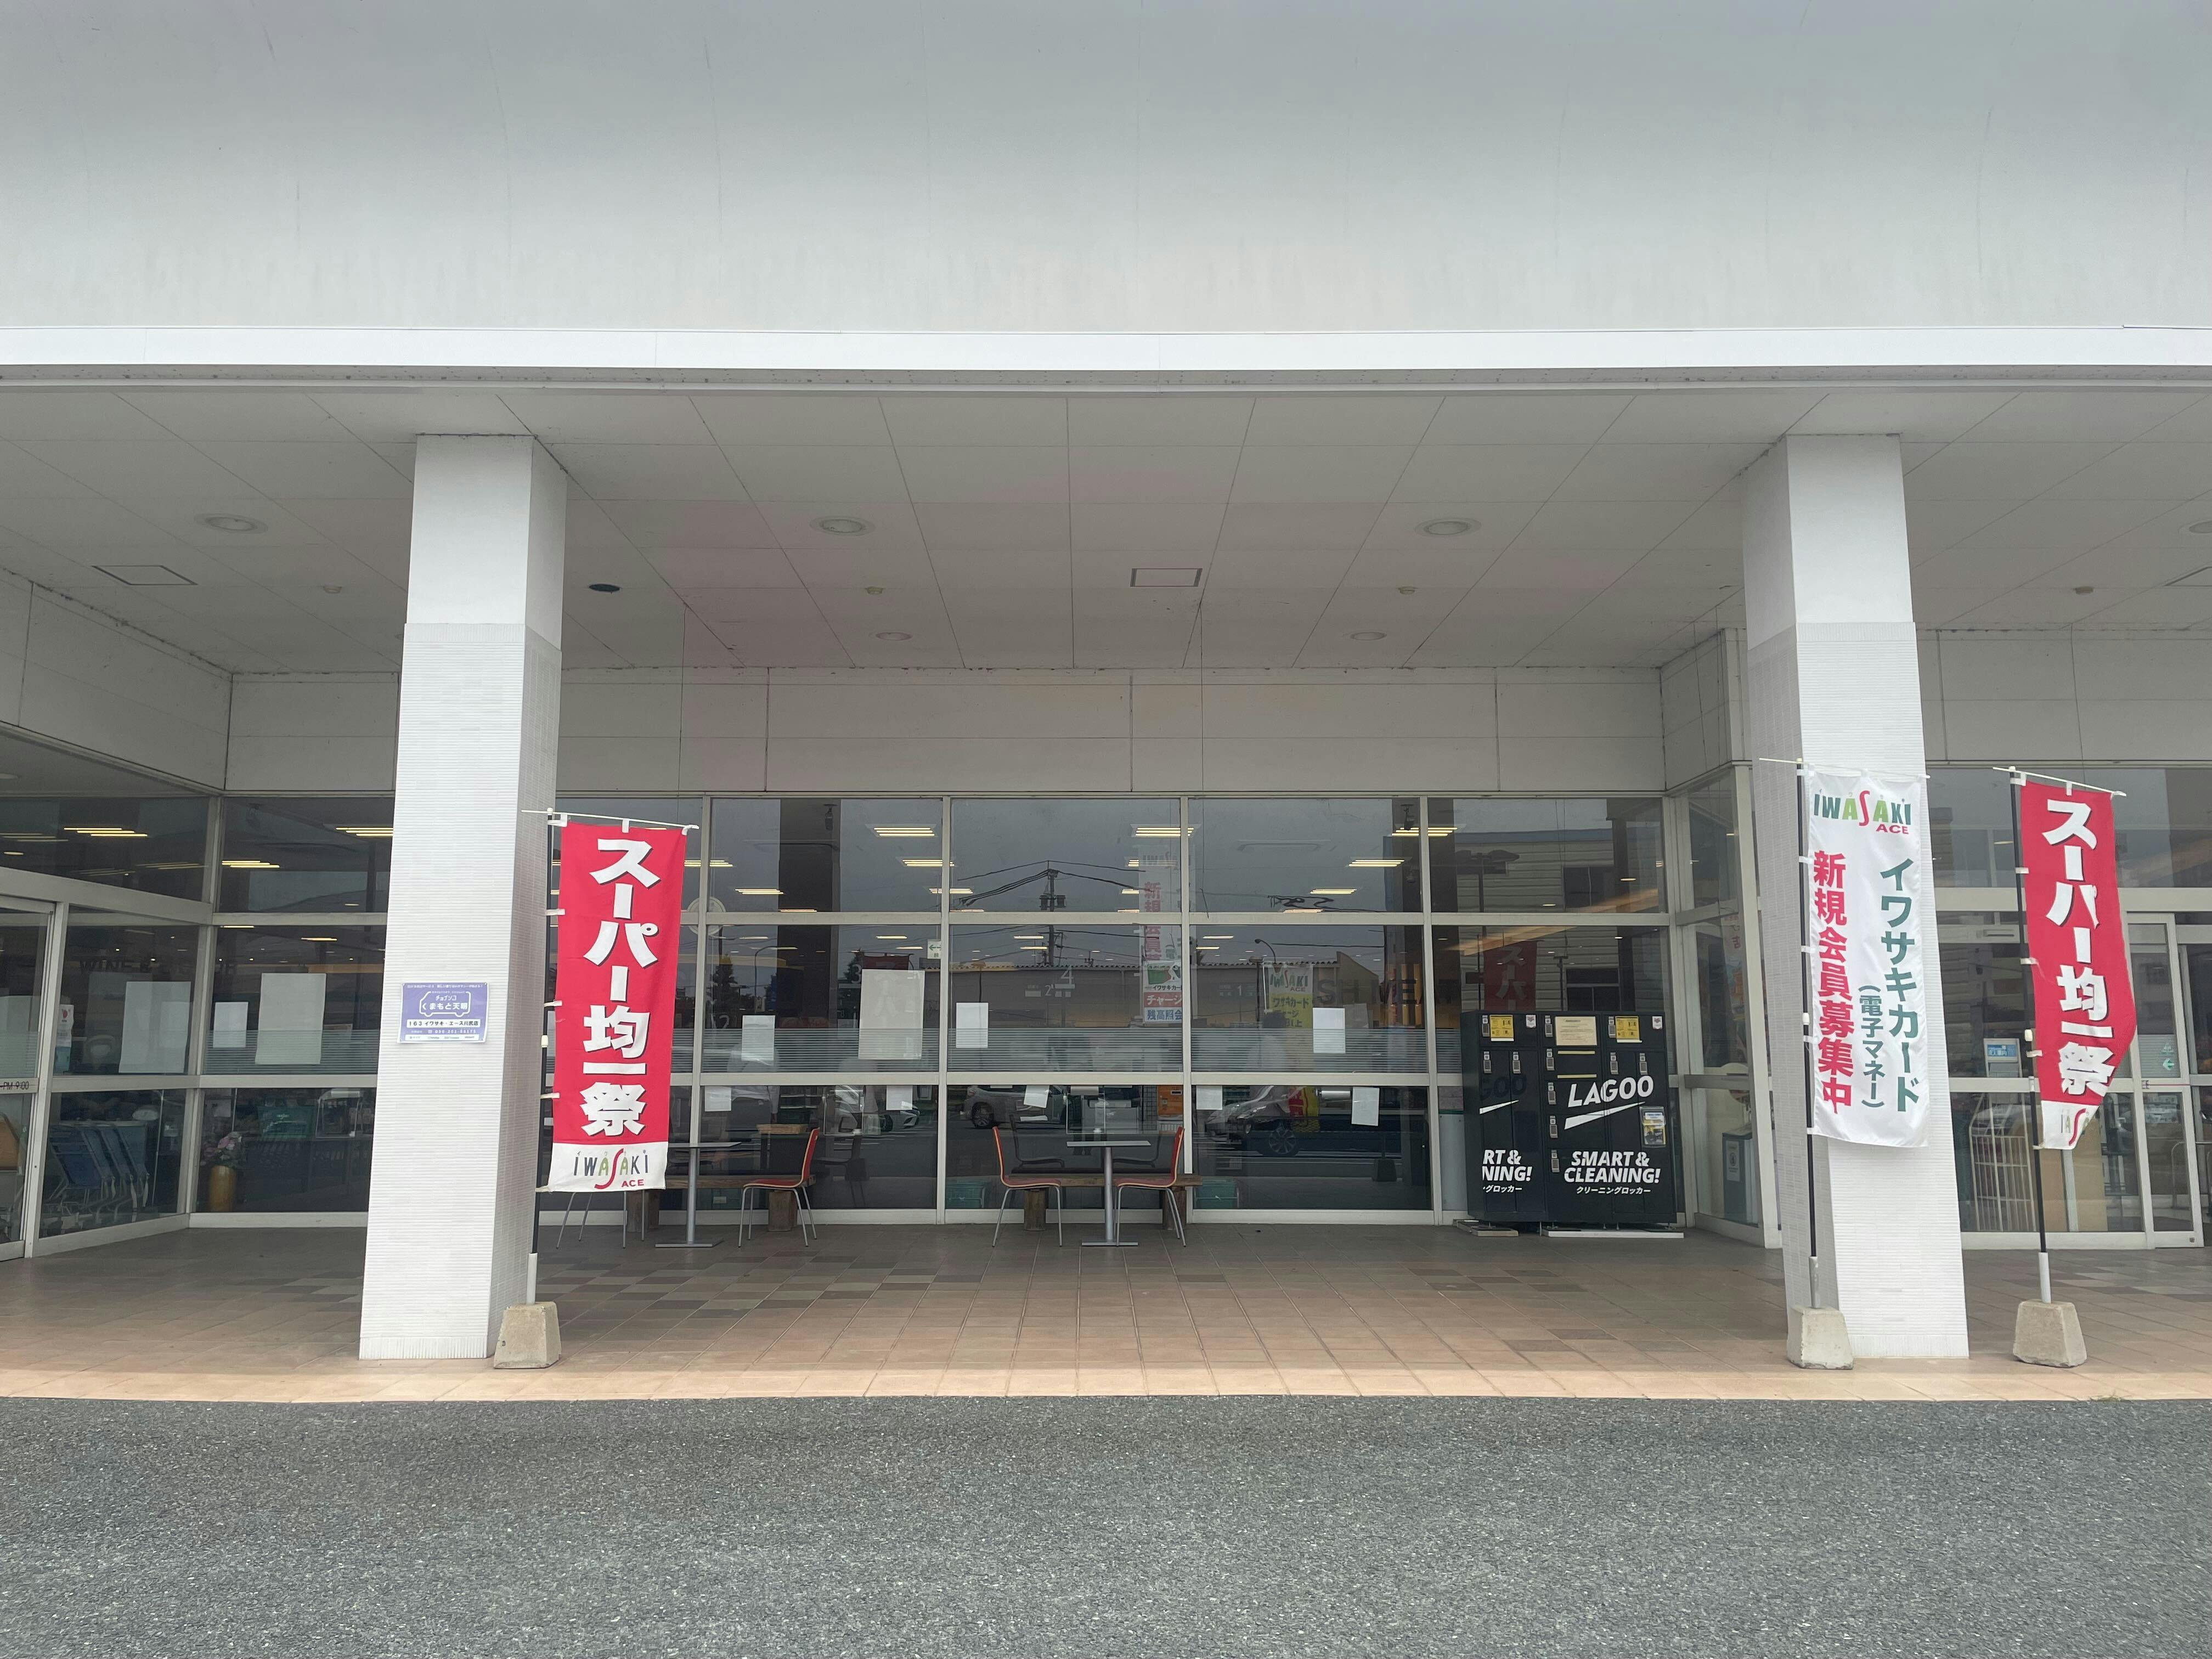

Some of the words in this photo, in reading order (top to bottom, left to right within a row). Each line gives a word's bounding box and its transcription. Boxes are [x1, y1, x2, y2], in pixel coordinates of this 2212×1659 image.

[1814, 790, 1911, 826] IWASAKI
[1876, 823, 1909, 834] ACE
[579, 838, 661, 1137] スーパー均一祭
[1814, 850, 1854, 1115] 新規会員募集中
[1880, 858, 1920, 1112] イワサキカード
[1858, 985, 1885, 1108] （電子マネー）
[1567, 1075, 1654, 1108] LAGOO
[573, 1148, 648, 1189] IWASAKI
[1506, 1149, 1522, 1165] &
[1571, 1150, 1634, 1166] SMART
[1635, 1151, 1650, 1167] &
[621, 1179, 645, 1188] ACE
[1564, 1167, 1661, 1184] CLEANING!
[1482, 1184, 1522, 1193] グロッカー
[1576, 1186, 1651, 1195] クリーニングロッカー
